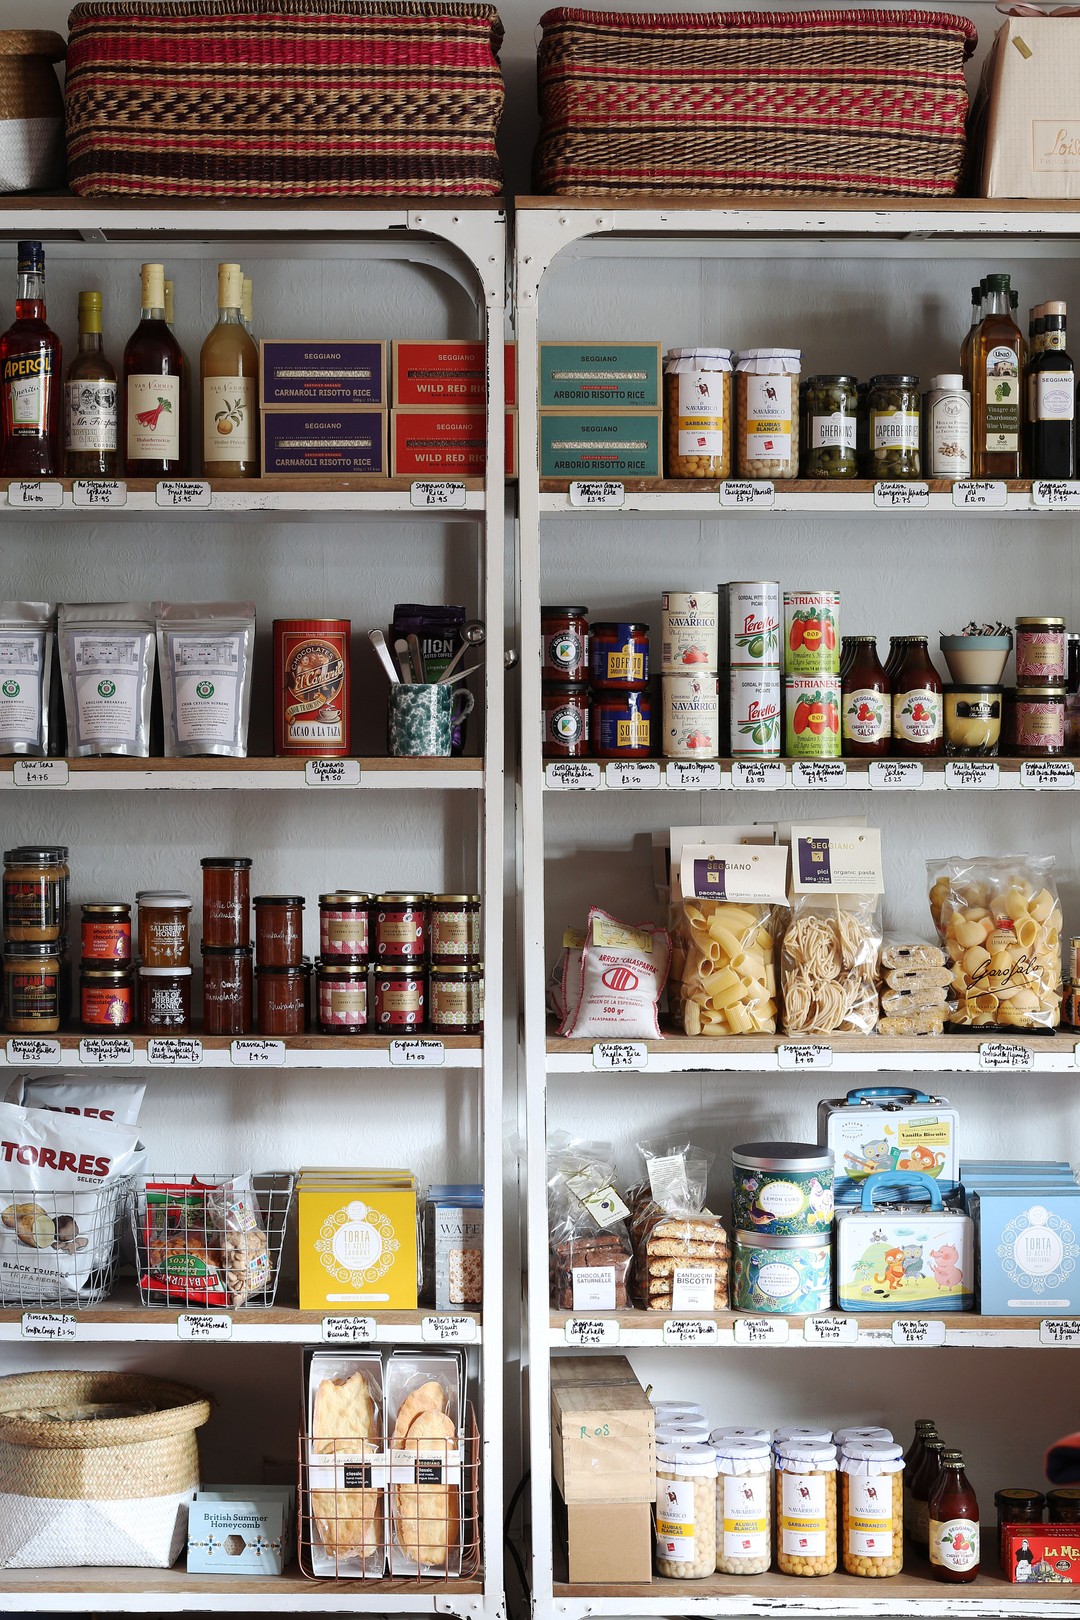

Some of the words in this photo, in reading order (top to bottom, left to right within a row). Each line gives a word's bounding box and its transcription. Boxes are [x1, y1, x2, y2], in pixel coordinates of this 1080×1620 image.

[5, 358, 50, 378] APEROL
[275, 389, 316, 397] CARNAROLI
[319, 389, 351, 397] RISOTTO
[353, 389, 371, 397] RICE
[417, 384, 444, 393] WILD
[447, 384, 467, 393] RED
[554, 391, 590, 399] ARBORIO
[592, 391, 625, 399] RISOTTO
[627, 391, 645, 399] RICE
[415, 454, 442, 462] WILD
[446, 454, 465, 462] RED
[554, 461, 590, 469] ARBORIO
[592, 461, 625, 469] RISOTTO
[627, 461, 645, 469] RICE
[427, 496, 448, 504] £3.95
[789, 597, 834, 605] STRIANESE
[291, 646, 334, 670] CHOCOLATES
[794, 680, 838, 689] STRIANESE
[854, 696, 879, 704] SEGGIANO
[908, 696, 933, 704] SEGGIANO
[289, 726, 309, 737] CACAO
[311, 726, 315, 736] A
[317, 726, 325, 737] LA
[327, 726, 341, 737] TAZA
[707, 863, 752, 871] SEGGIANO
[599, 955, 619, 963] ARROZ
[967, 955, 1044, 990] Garofalo
[1, 1141, 111, 1176] TORRES
[344, 1230, 371, 1242] TORTA
[1025, 1237, 1052, 1250] TORTA
[2, 1262, 31, 1273] BLACK
[203, 1513, 231, 1521] British
[233, 1514, 268, 1522] Summer
[211, 1520, 260, 1530] Honeycomb
[1045, 1546, 1059, 1557] LA
